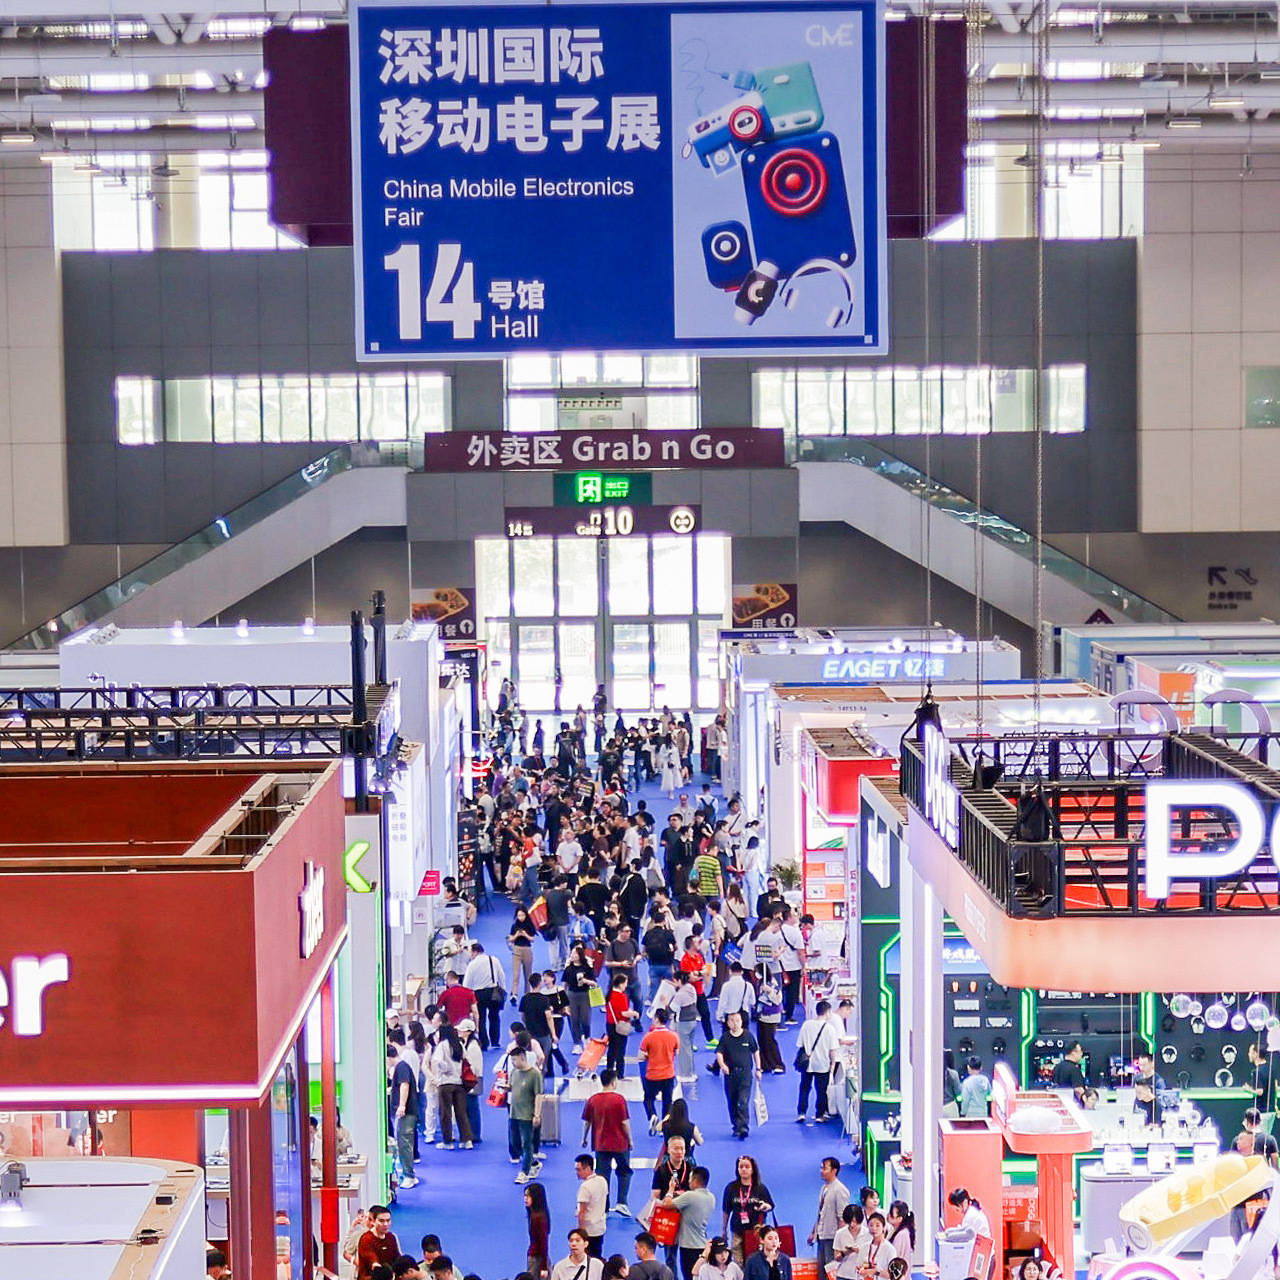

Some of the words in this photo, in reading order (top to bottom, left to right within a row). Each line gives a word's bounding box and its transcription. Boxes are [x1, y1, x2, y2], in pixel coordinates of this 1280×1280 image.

[378, 27, 604, 84] 深圳国际
[378, 96, 662, 155] 移动电子展
[383, 179, 442, 199] China
[449, 178, 516, 198] Mobile
[522, 176, 635, 197] Electronics
[383, 206, 425, 227] Fair
[383, 242, 482, 342] 14
[487, 280, 546, 312] 号馆
[490, 314, 540, 339] Hall
[468, 435, 563, 466] 外卖区
[572, 434, 651, 461] Grab
[661, 439, 680, 453] n
[690, 434, 735, 460] Go
[604, 507, 634, 535] 10
[823, 659, 901, 678] EAGET
